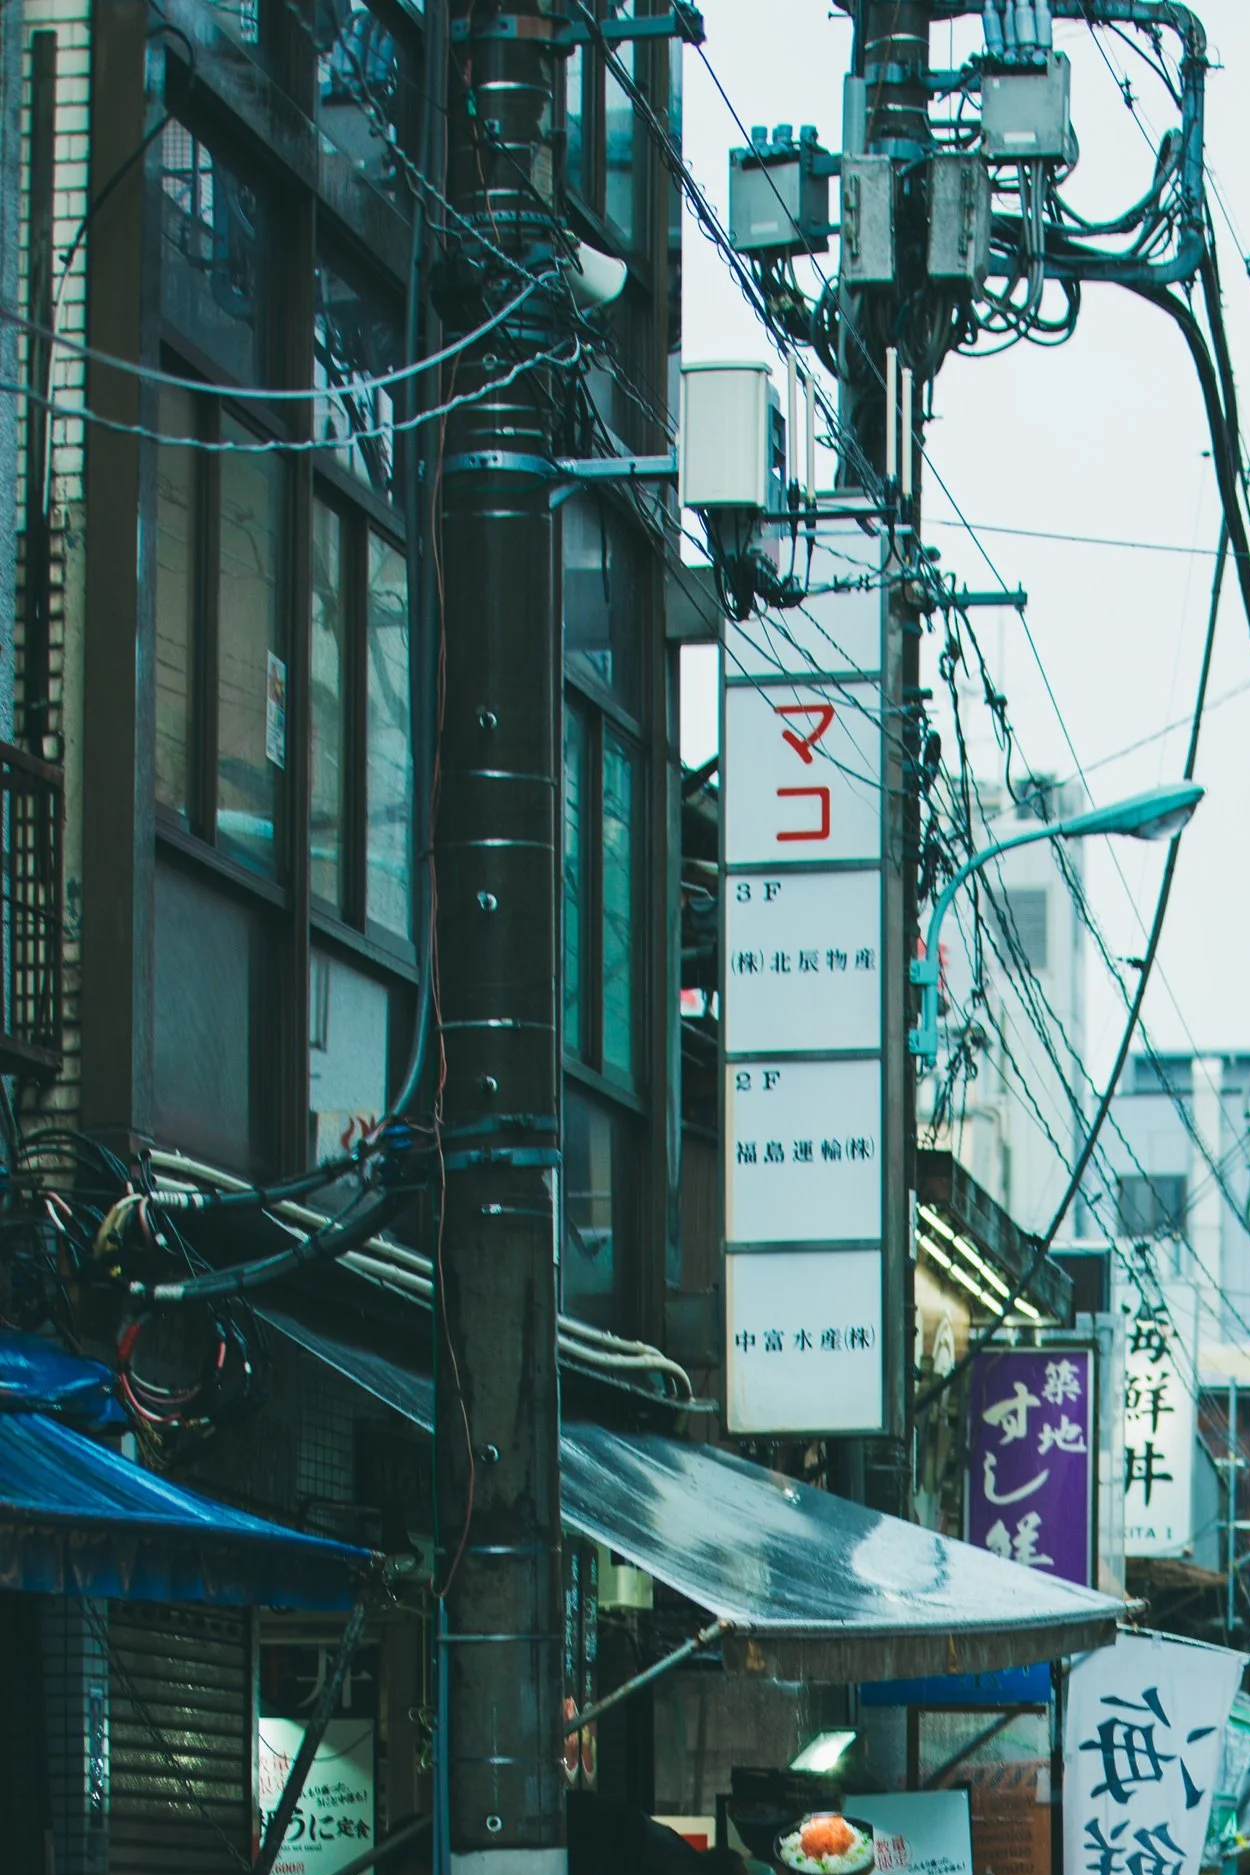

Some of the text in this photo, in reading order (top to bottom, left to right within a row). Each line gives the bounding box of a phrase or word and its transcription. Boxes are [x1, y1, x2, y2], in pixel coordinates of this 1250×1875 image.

[774, 703, 835, 841] マコ
[1039, 1359, 1088, 1456] 築地
[260, 1807, 371, 1842] うに定食
